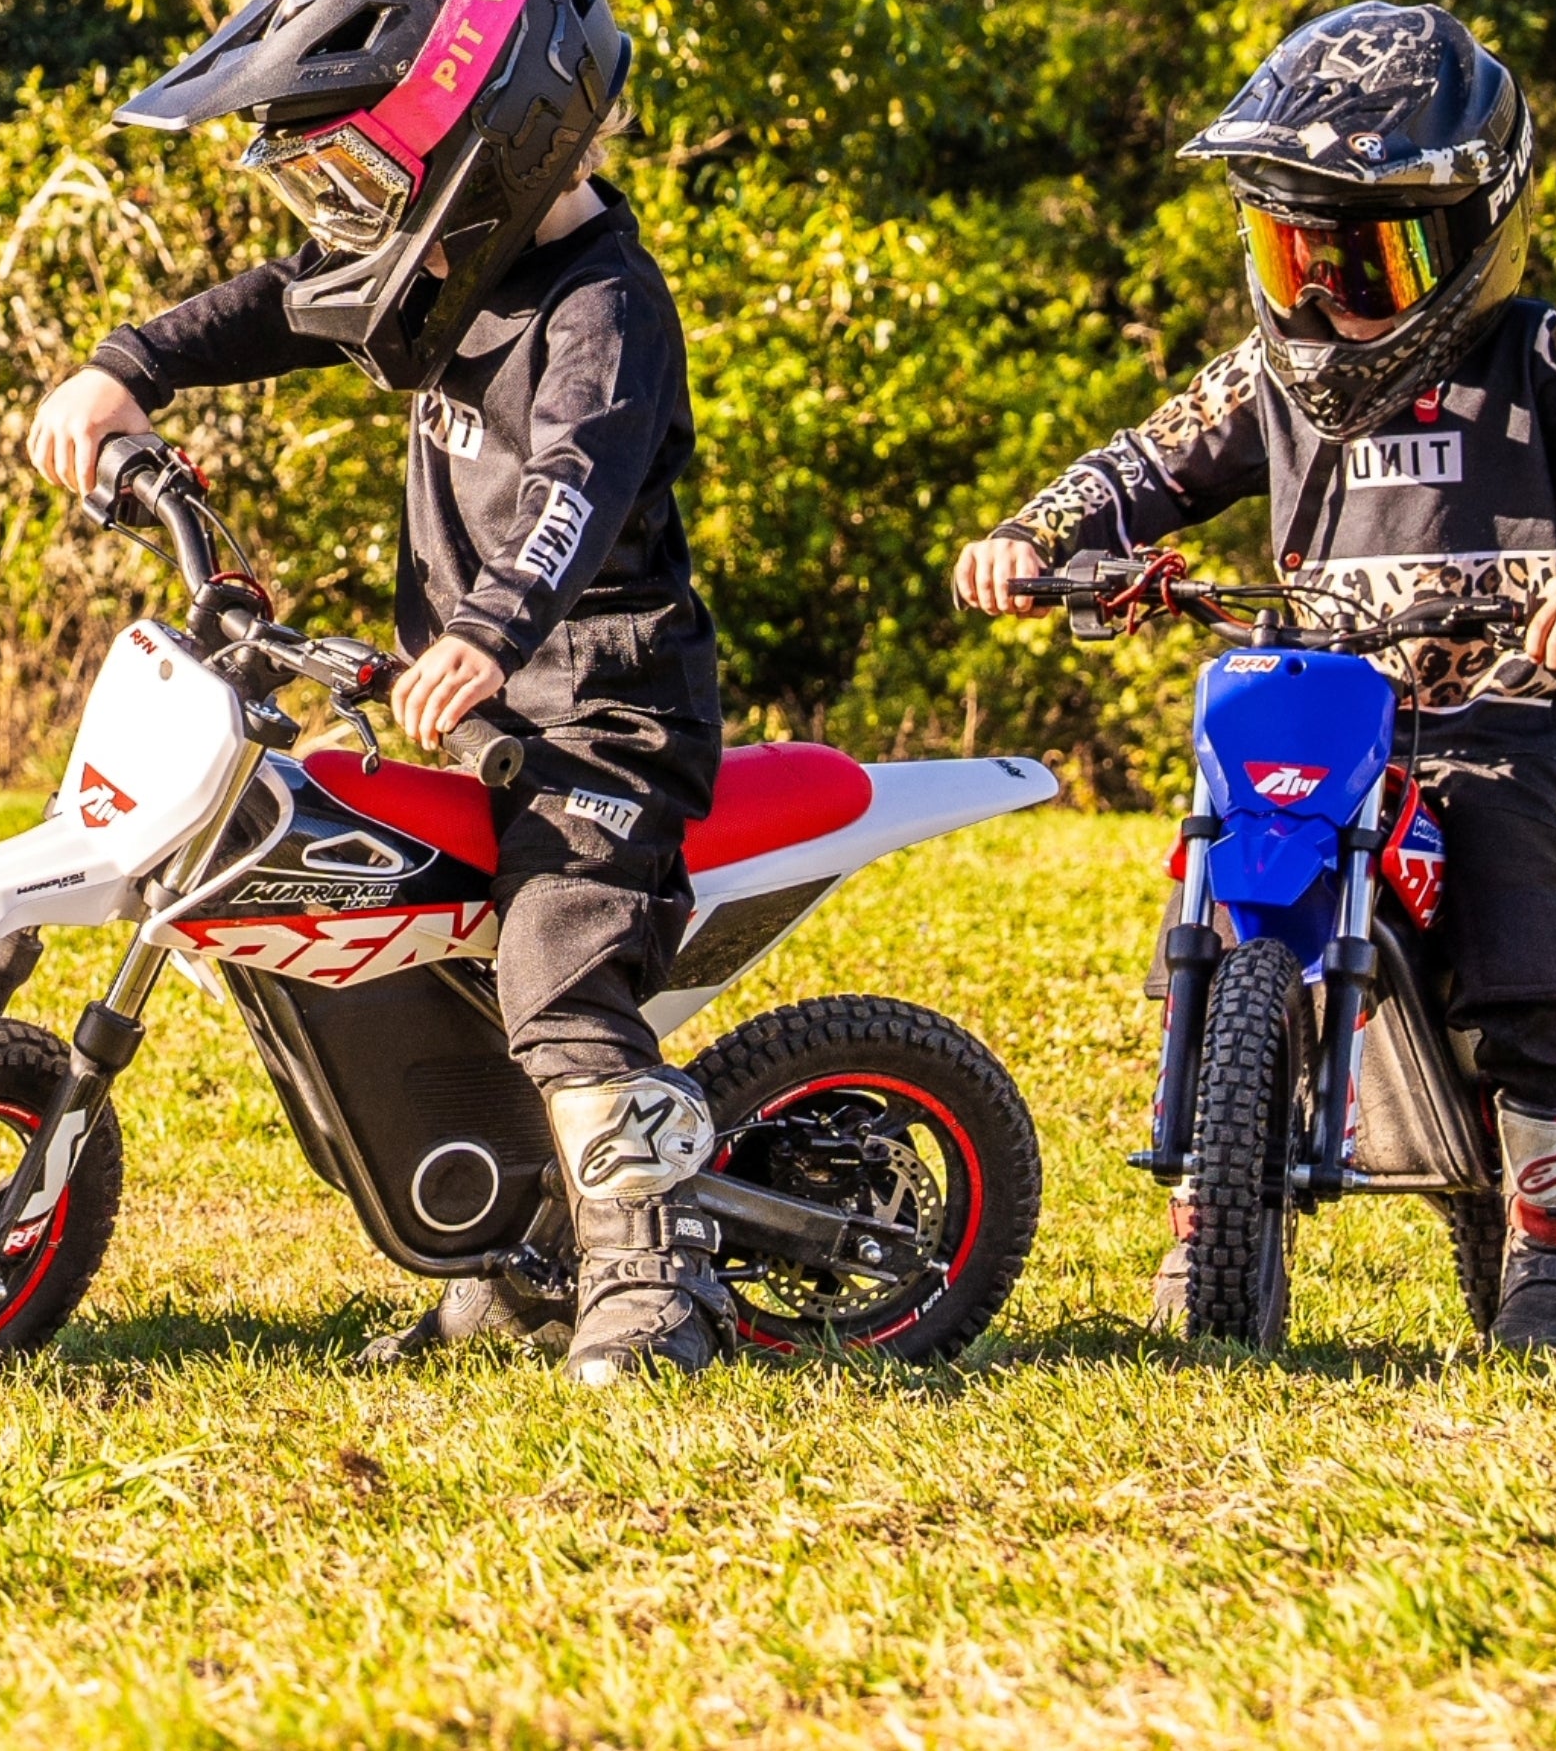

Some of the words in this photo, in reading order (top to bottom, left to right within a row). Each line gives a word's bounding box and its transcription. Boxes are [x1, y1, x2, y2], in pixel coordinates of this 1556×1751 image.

[431, 17, 485, 92] PIT
[421, 393, 477, 449] NIT
[1352, 440, 1451, 479] UNIT
[526, 489, 583, 578] UNIT
[129, 628, 159, 655] RFN
[1226, 656, 1279, 672] RFN
[575, 793, 633, 830] UNIT
[230, 881, 359, 904] WARRIOR
[356, 882, 400, 899] KIDS
